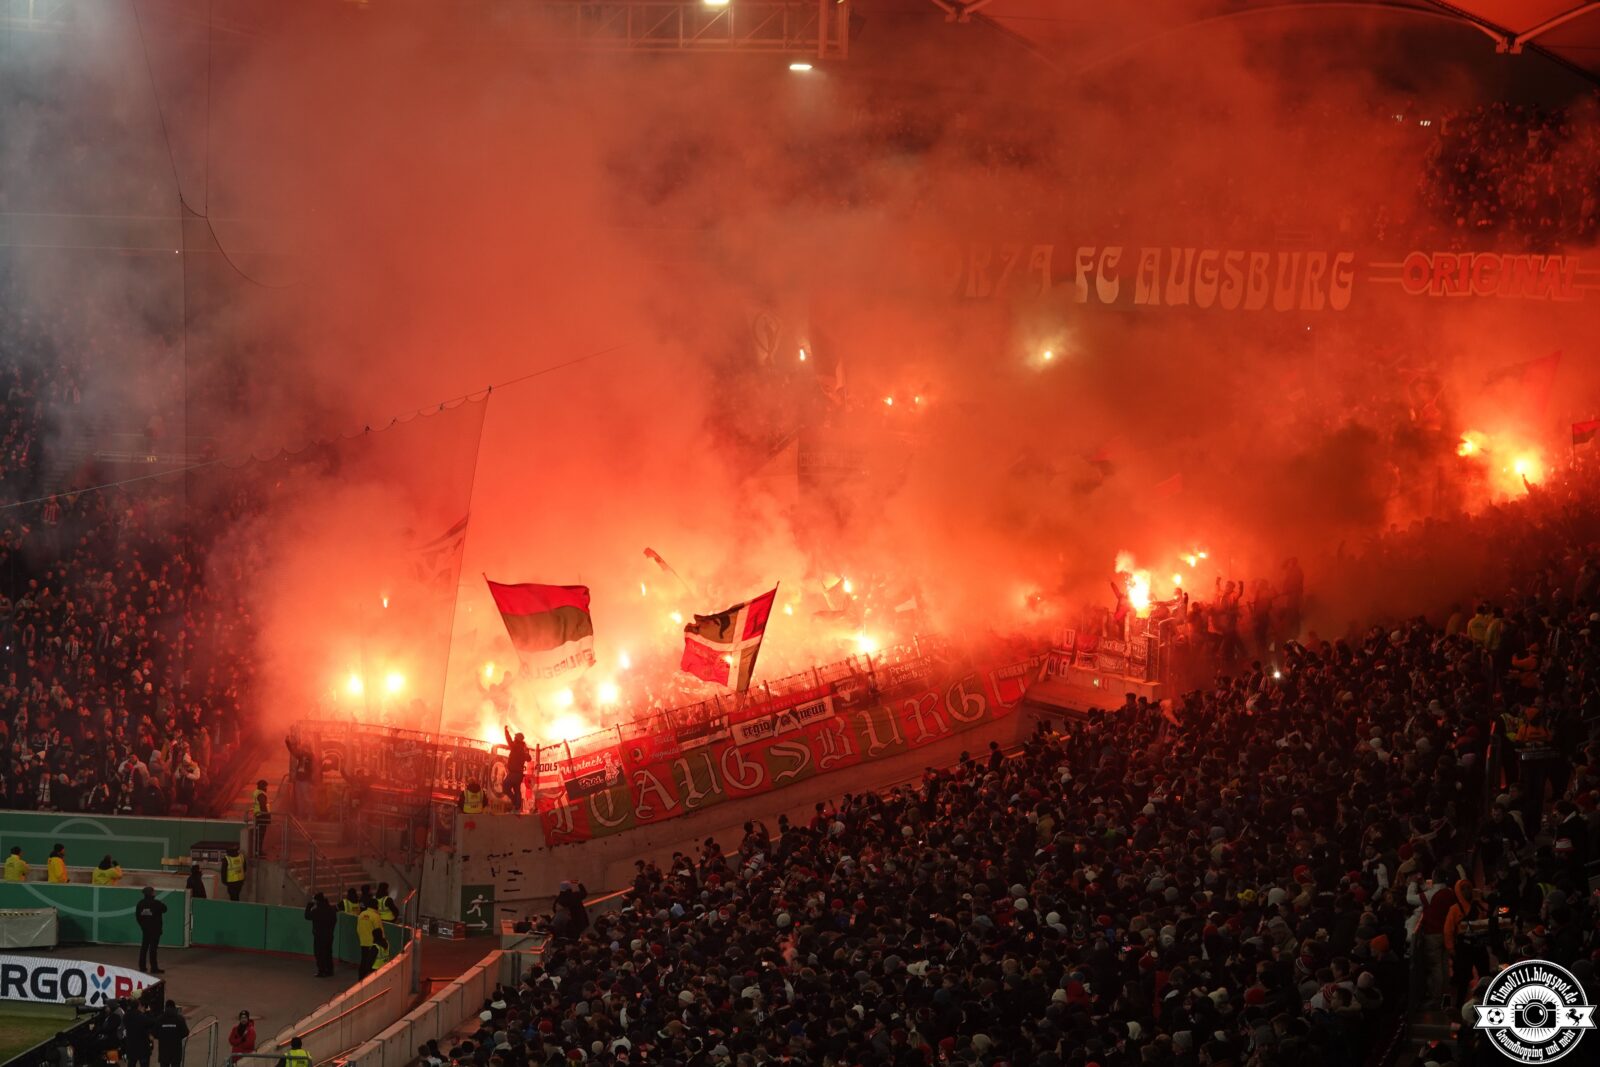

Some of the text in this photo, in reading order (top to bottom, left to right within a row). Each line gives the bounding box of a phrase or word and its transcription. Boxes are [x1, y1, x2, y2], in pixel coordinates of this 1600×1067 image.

[1074, 245, 1124, 304] FC
[1134, 247, 1355, 313] AUGSBURG
[1400, 251, 1585, 301] ORIGINAL
[799, 702, 827, 720] neun
[535, 762, 558, 773] OOLS
[632, 674, 987, 820] AUGSBURG
